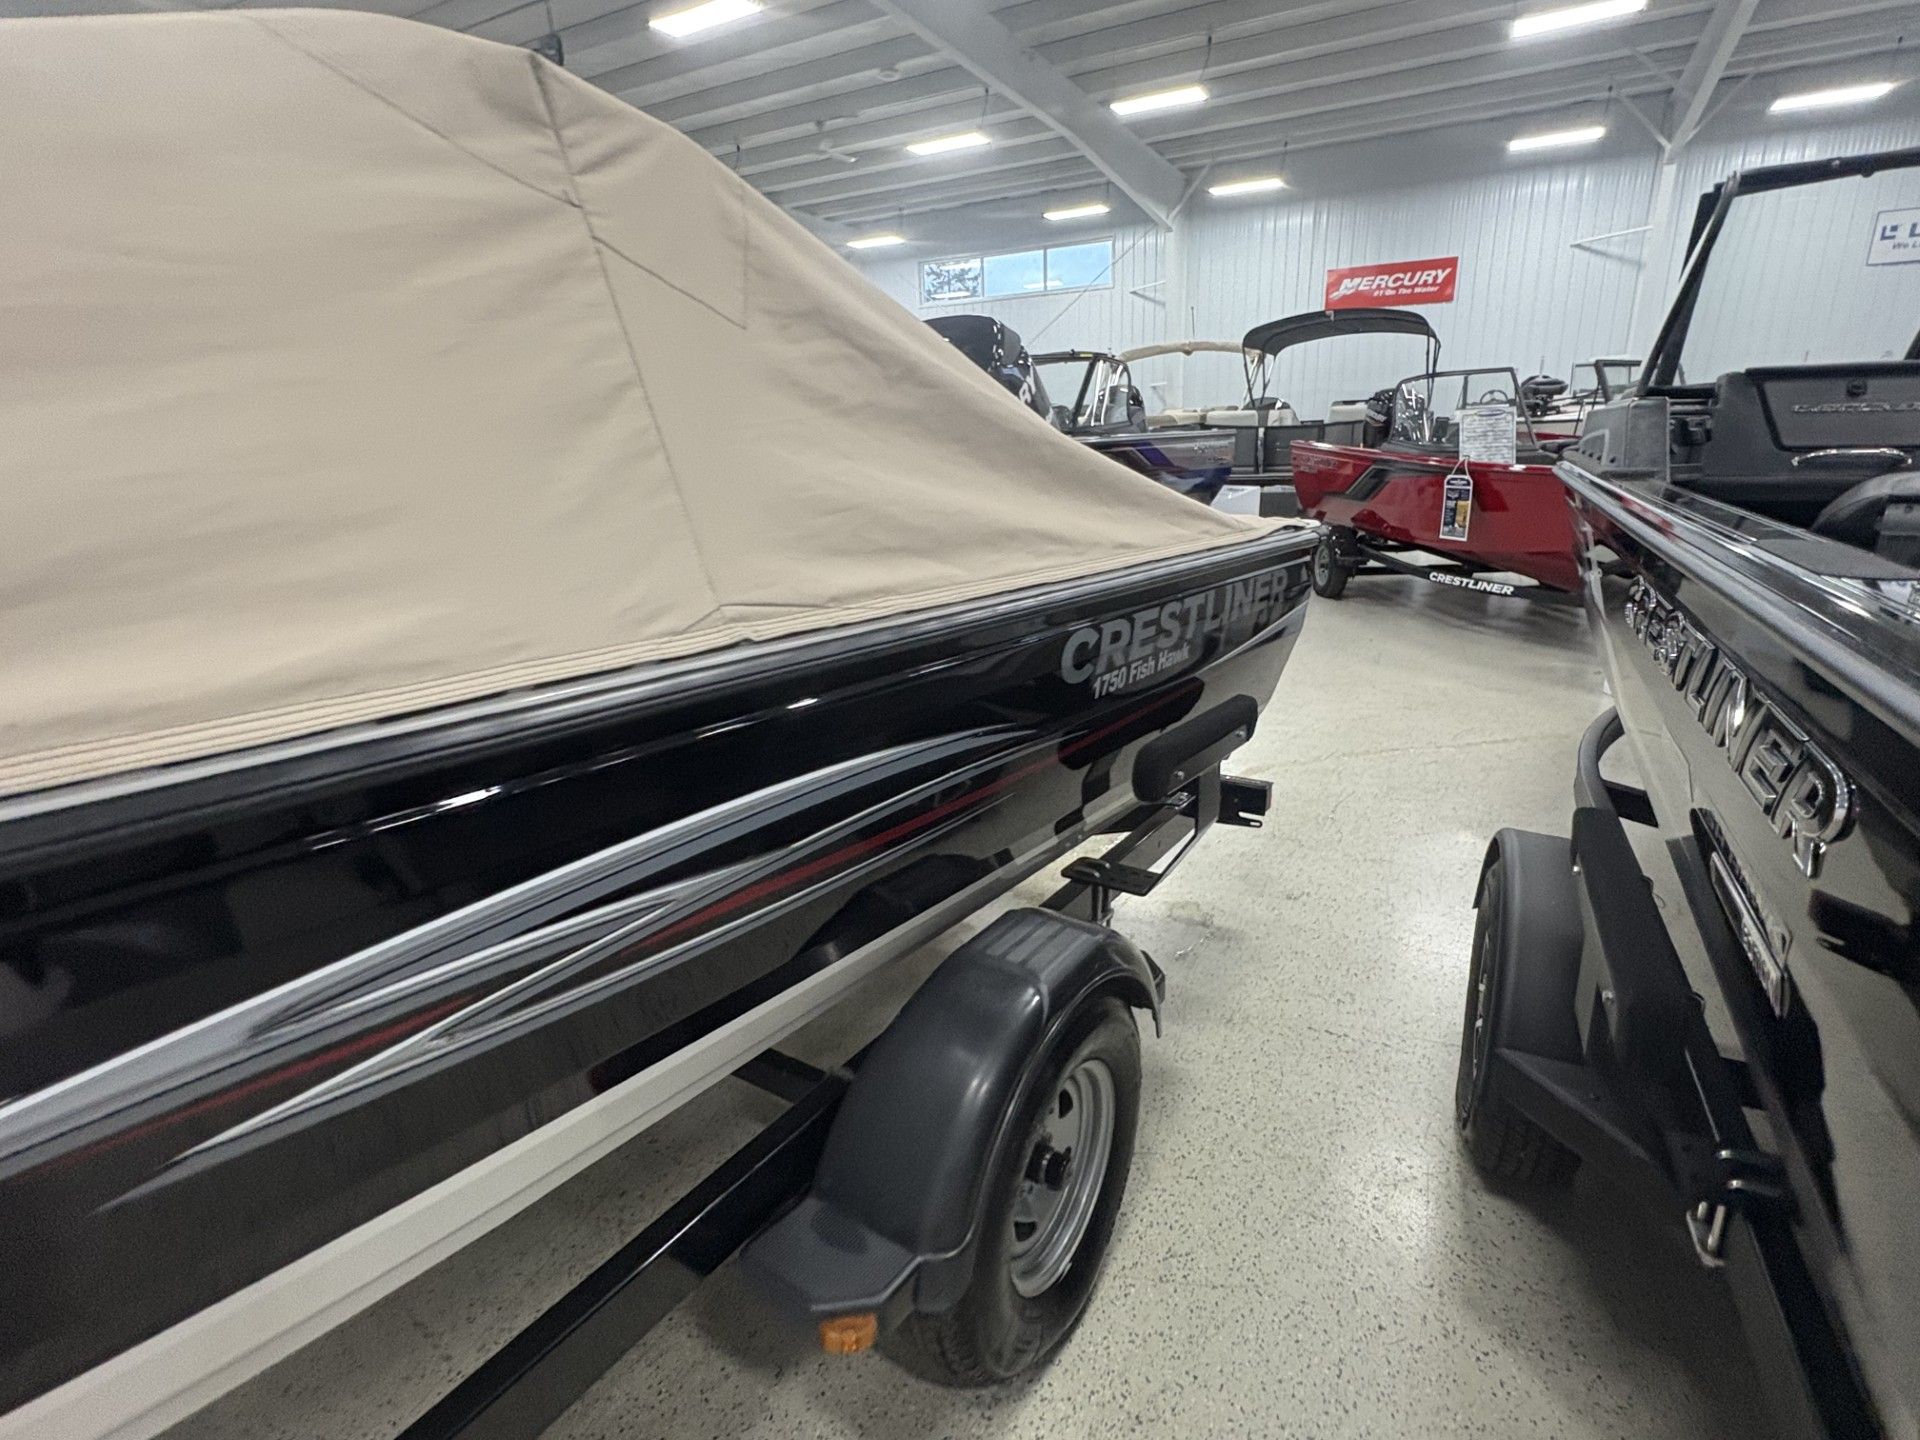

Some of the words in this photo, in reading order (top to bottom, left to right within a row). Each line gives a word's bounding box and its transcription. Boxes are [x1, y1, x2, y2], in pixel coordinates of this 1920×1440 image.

[1332, 267, 1452, 296] MERCURY
[1397, 287, 1412, 295] The
[1413, 286, 1440, 294] Water
[1428, 571, 1515, 595] CRESTLINER
[1061, 568, 1289, 685] CRESTLINER
[1093, 666, 1127, 700] 1750
[1129, 656, 1155, 684] Fish
[1157, 642, 1189, 672] Hawk
